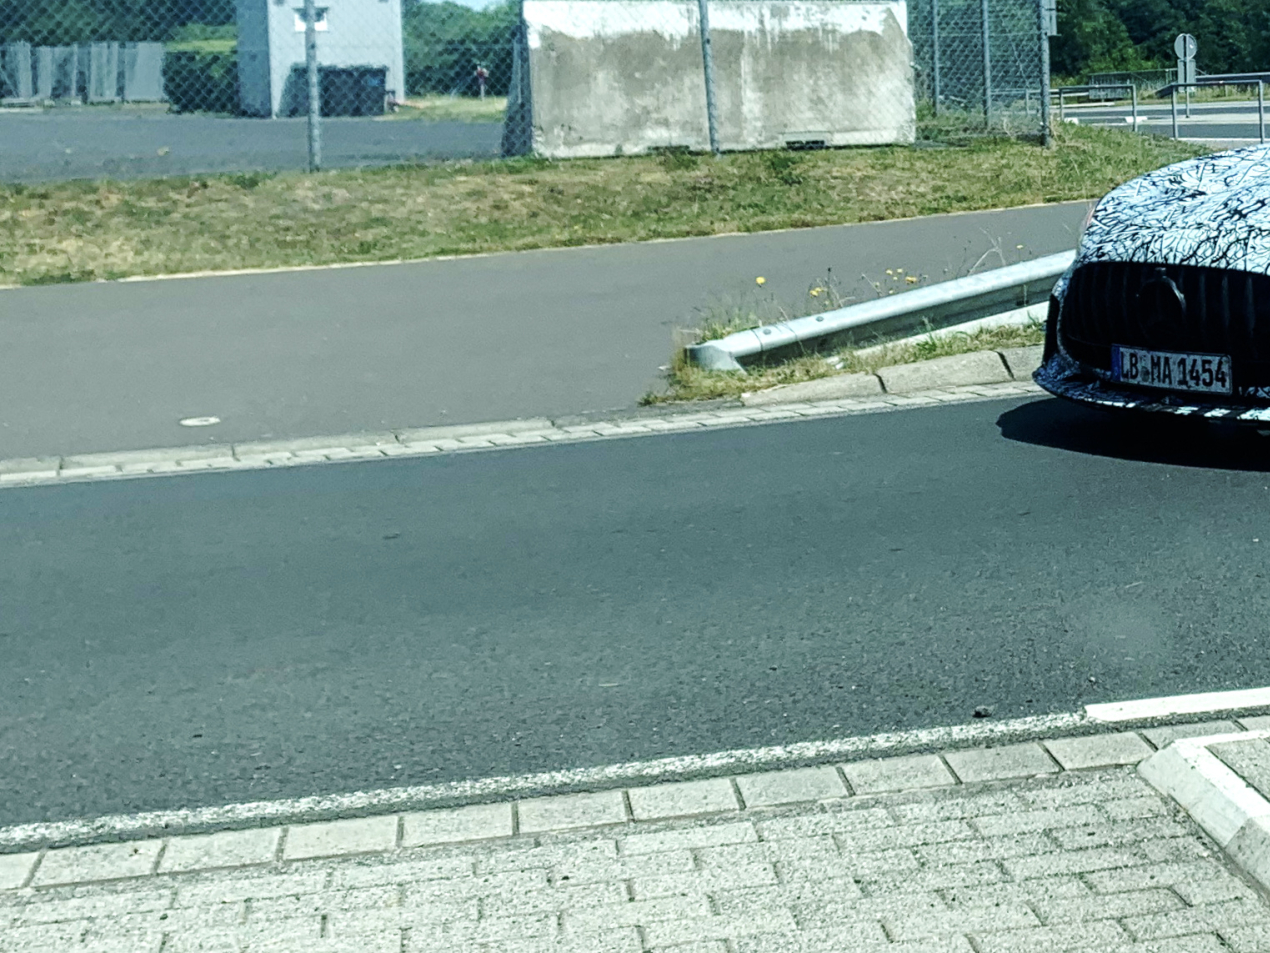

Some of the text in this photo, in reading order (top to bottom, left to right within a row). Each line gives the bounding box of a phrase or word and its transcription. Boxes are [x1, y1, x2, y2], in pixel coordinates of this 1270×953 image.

[1120, 351, 1227, 388] LB MA 1454
